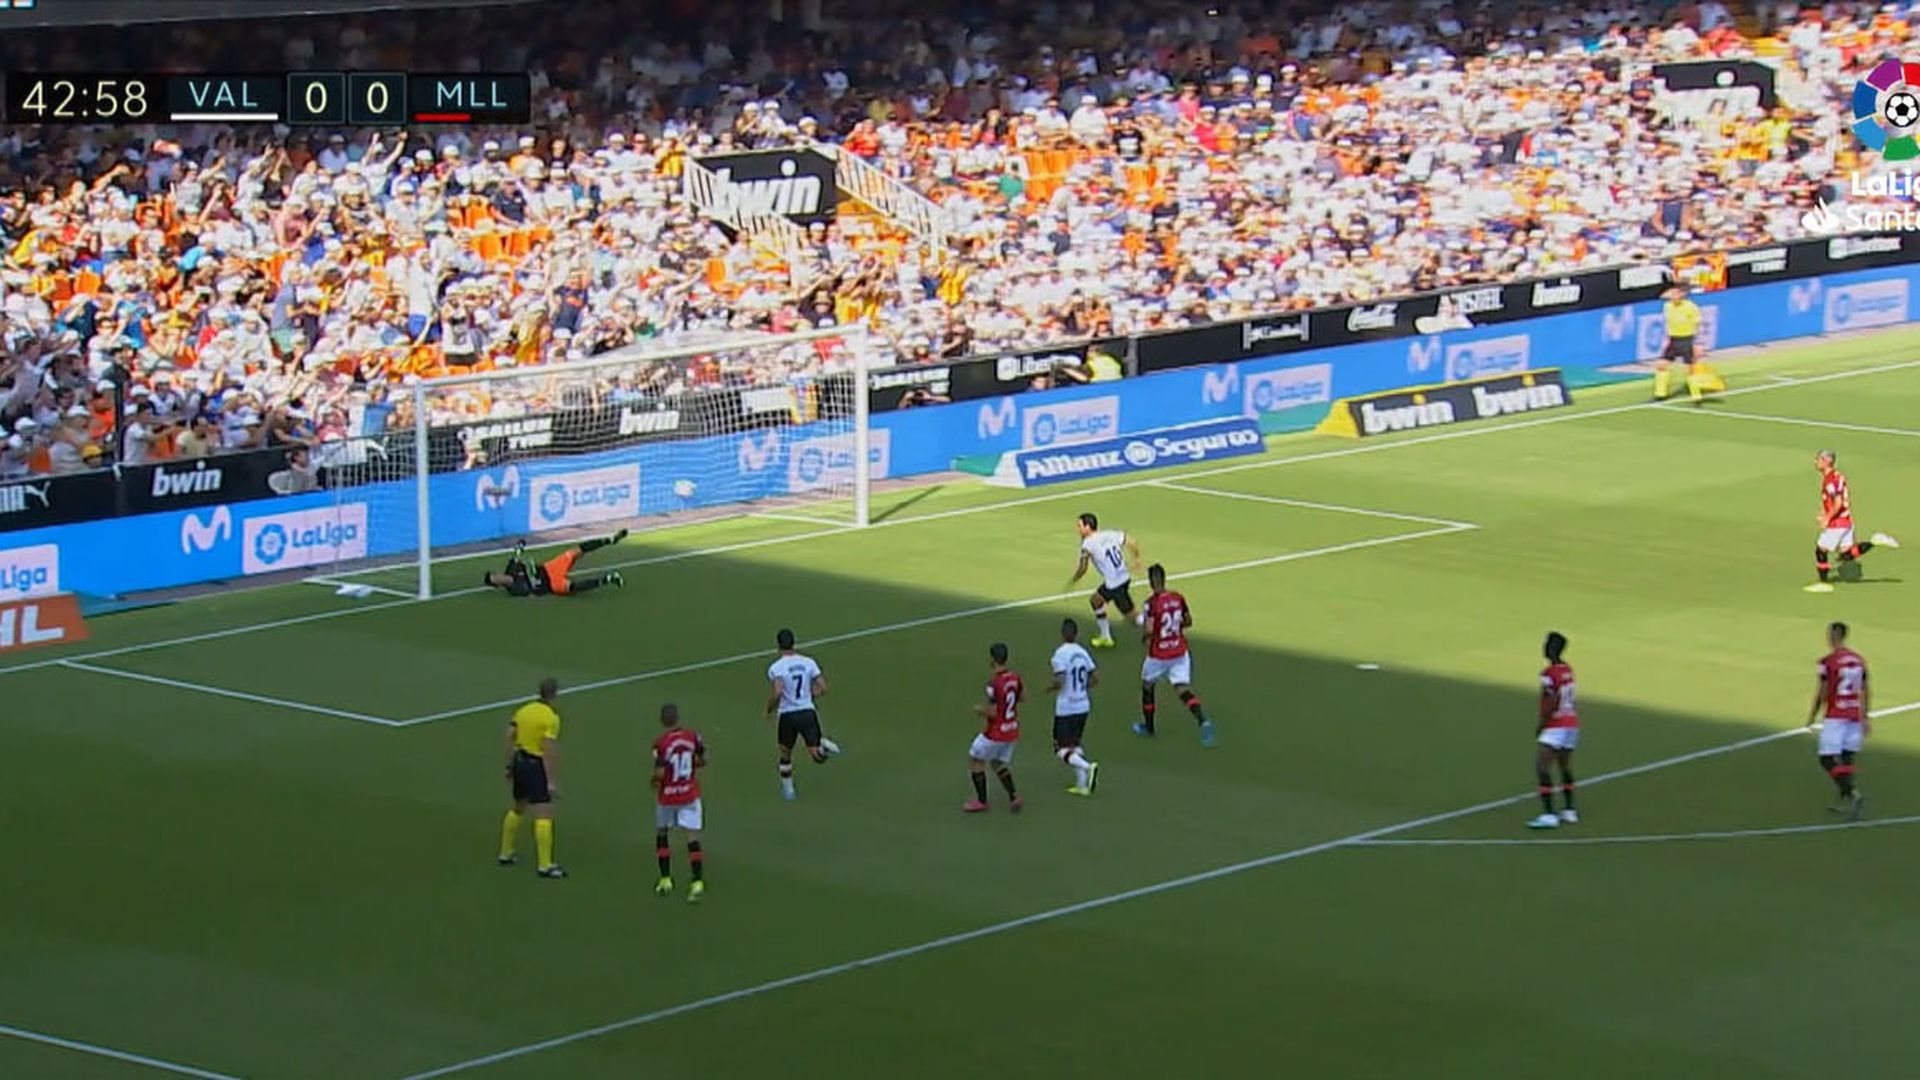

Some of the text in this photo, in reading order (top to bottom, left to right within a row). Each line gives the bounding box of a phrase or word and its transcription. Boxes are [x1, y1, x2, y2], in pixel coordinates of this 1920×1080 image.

[1361, 374, 1565, 434] bwin bwin
[1025, 427, 1259, 480] Allianz Seguros
[152, 460, 222, 497] bwin
[573, 483, 632, 506] LaLiga
[291, 521, 357, 548] LaLiga
[791, 673, 804, 700] 7
[1004, 691, 1016, 720] 2
[670, 751, 694, 782] 14
